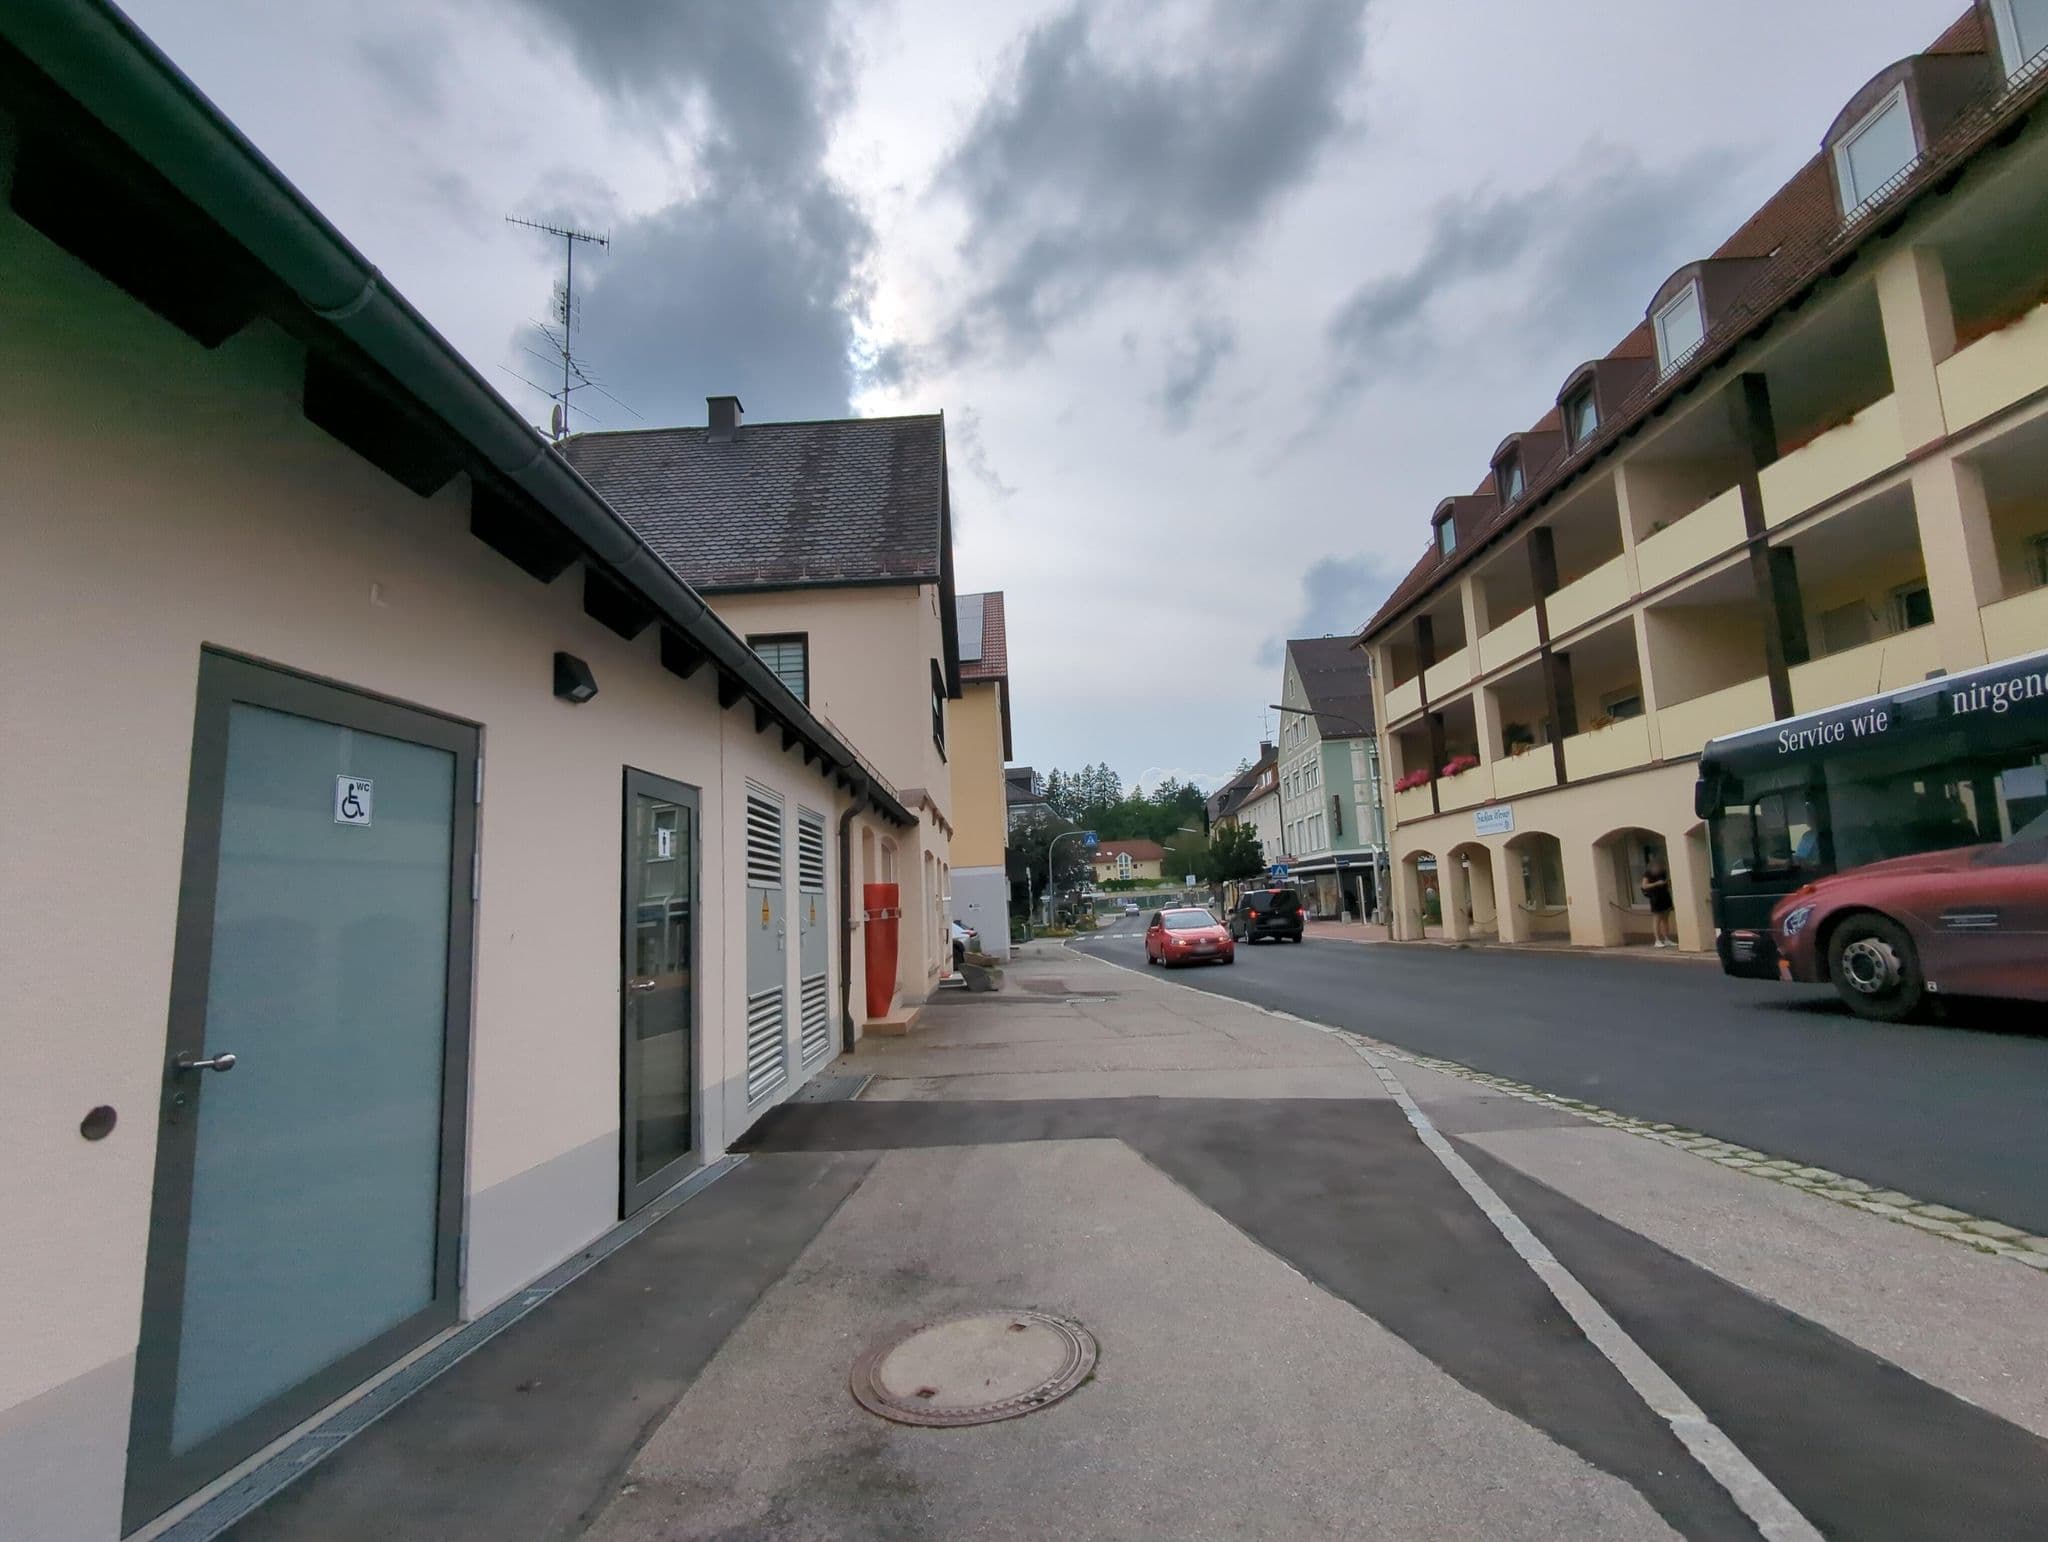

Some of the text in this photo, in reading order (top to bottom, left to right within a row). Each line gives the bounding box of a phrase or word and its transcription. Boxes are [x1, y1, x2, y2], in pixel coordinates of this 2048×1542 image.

[1778, 721, 1845, 754] Service
[1851, 708, 1888, 737] wie
[356, 782, 370, 792] WC
